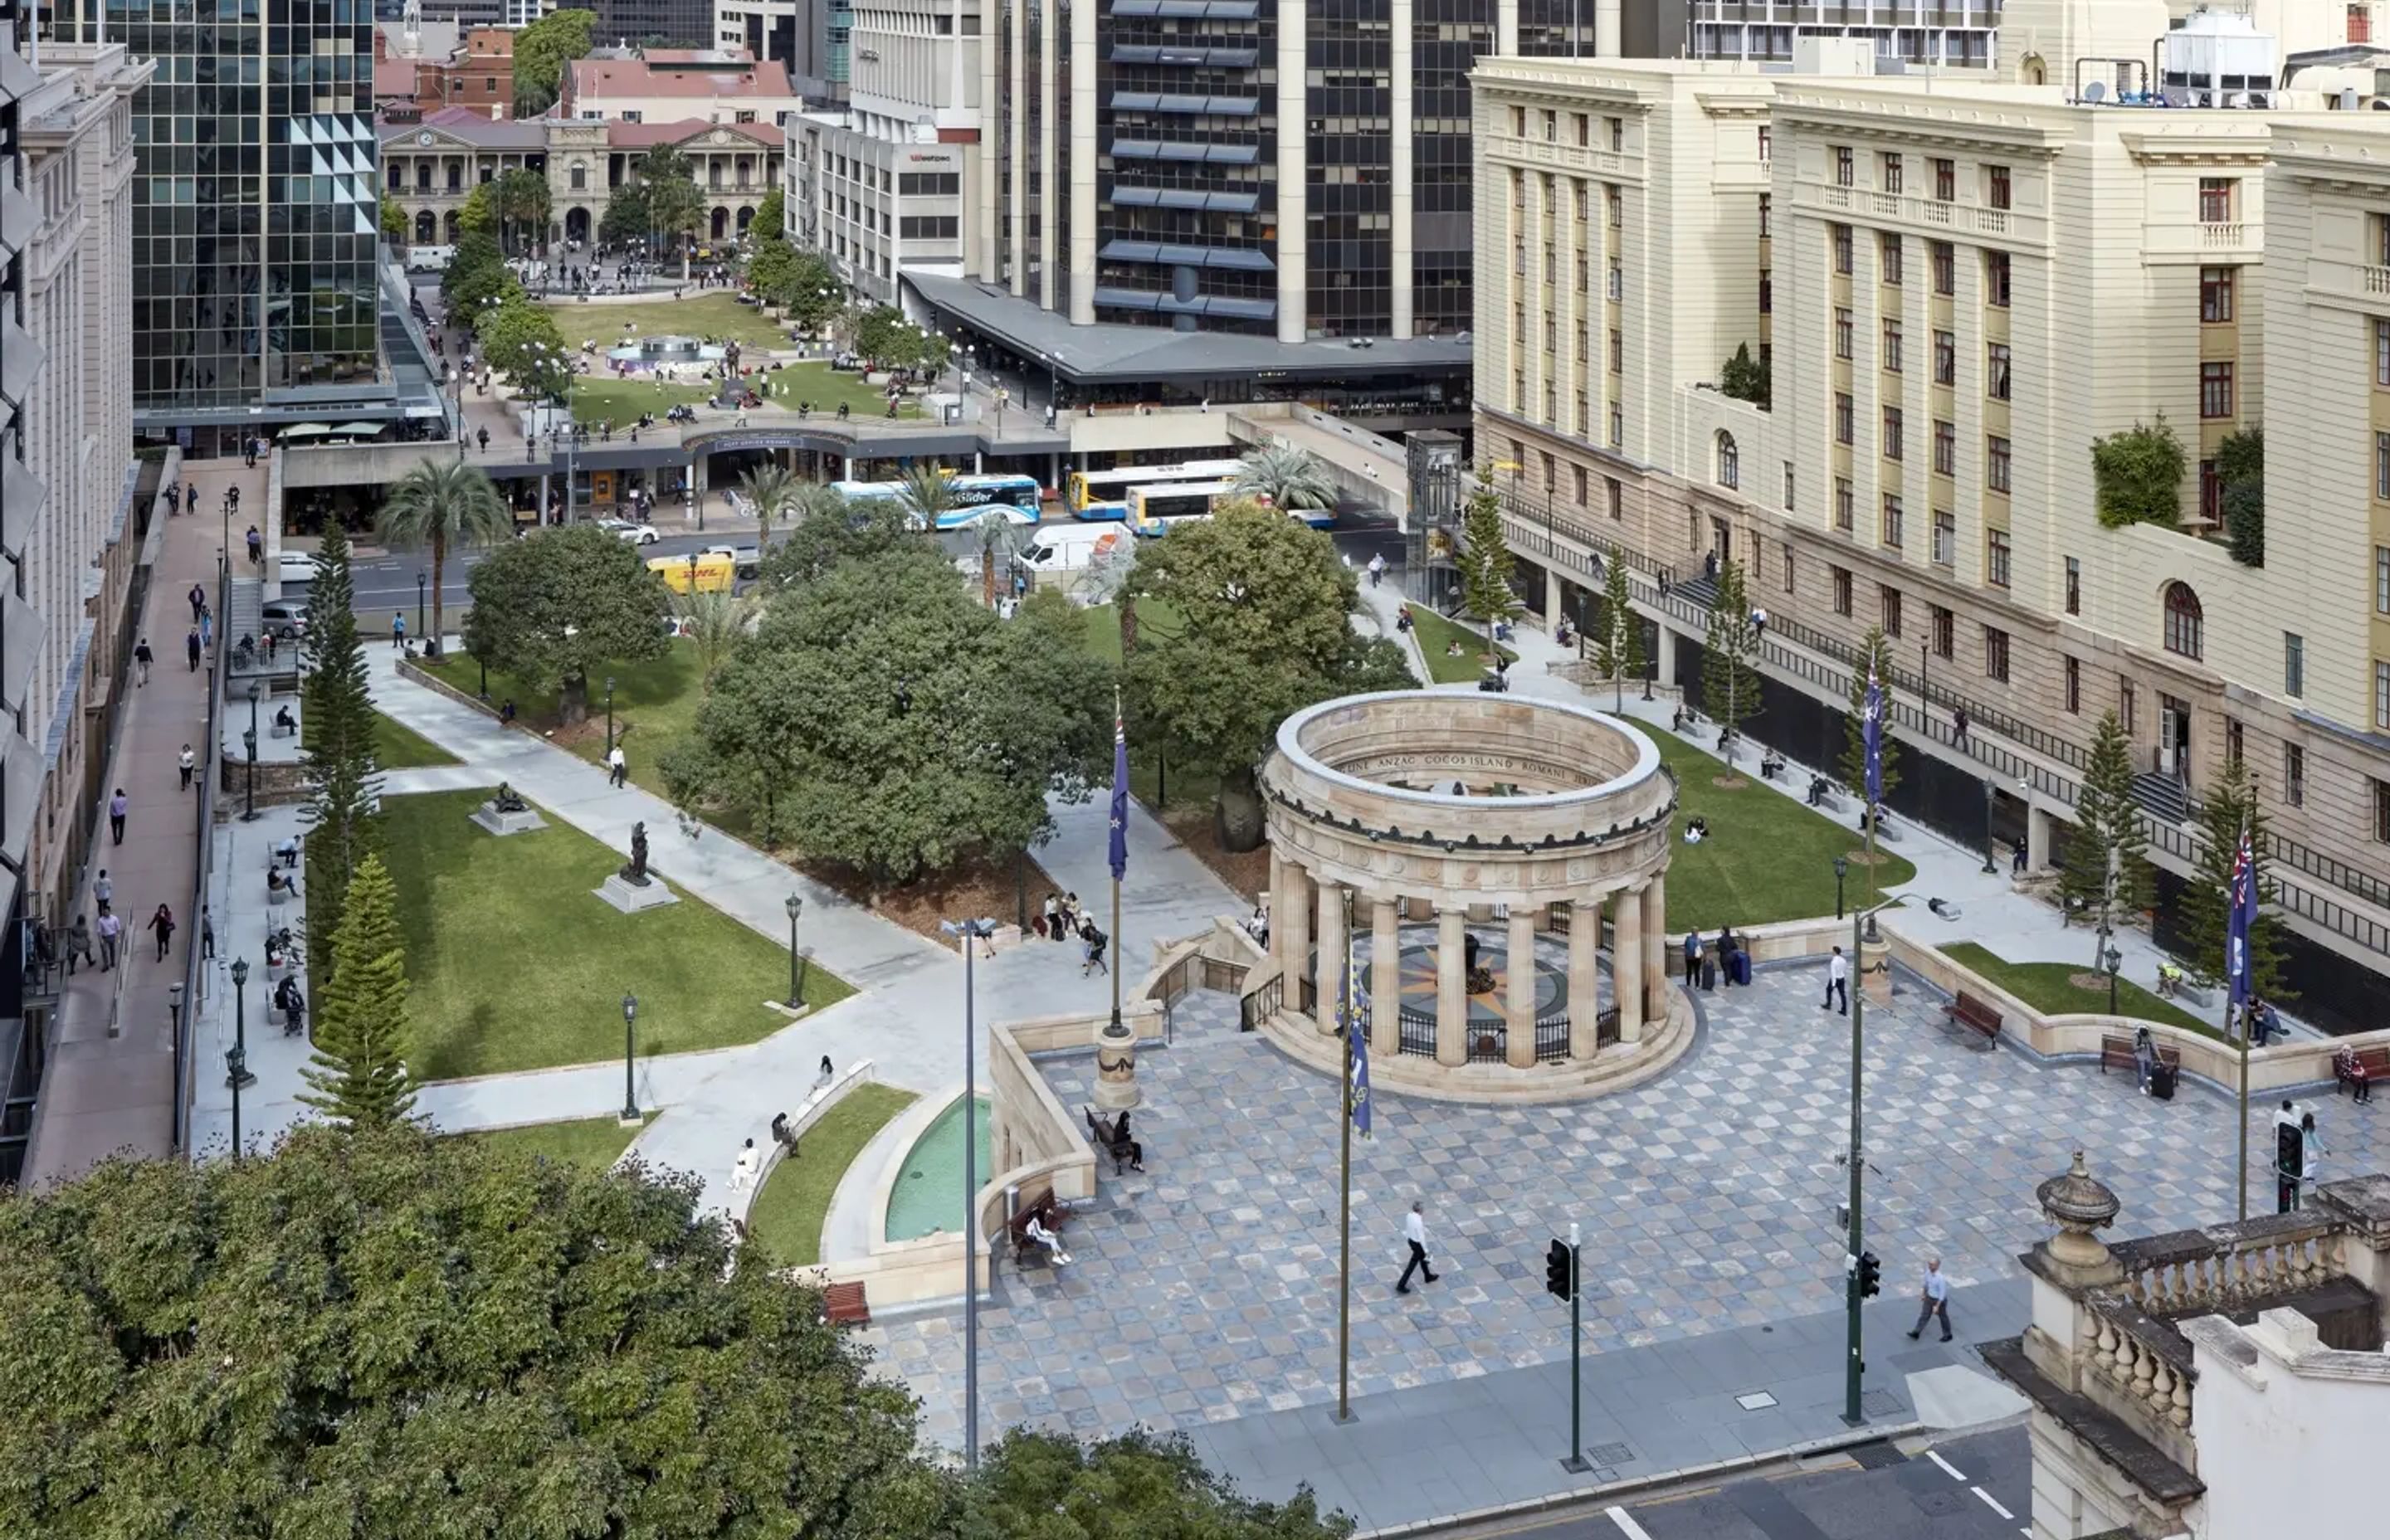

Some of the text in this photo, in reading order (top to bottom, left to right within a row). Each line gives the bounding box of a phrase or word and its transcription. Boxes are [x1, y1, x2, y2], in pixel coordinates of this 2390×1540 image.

[910, 154, 950, 163] Westpac
[1378, 756, 1416, 768] ANZAC
[1424, 755, 1466, 764] COCOS
[1471, 756, 1513, 768] ISLAND
[1522, 761, 1565, 778] ROMANI
